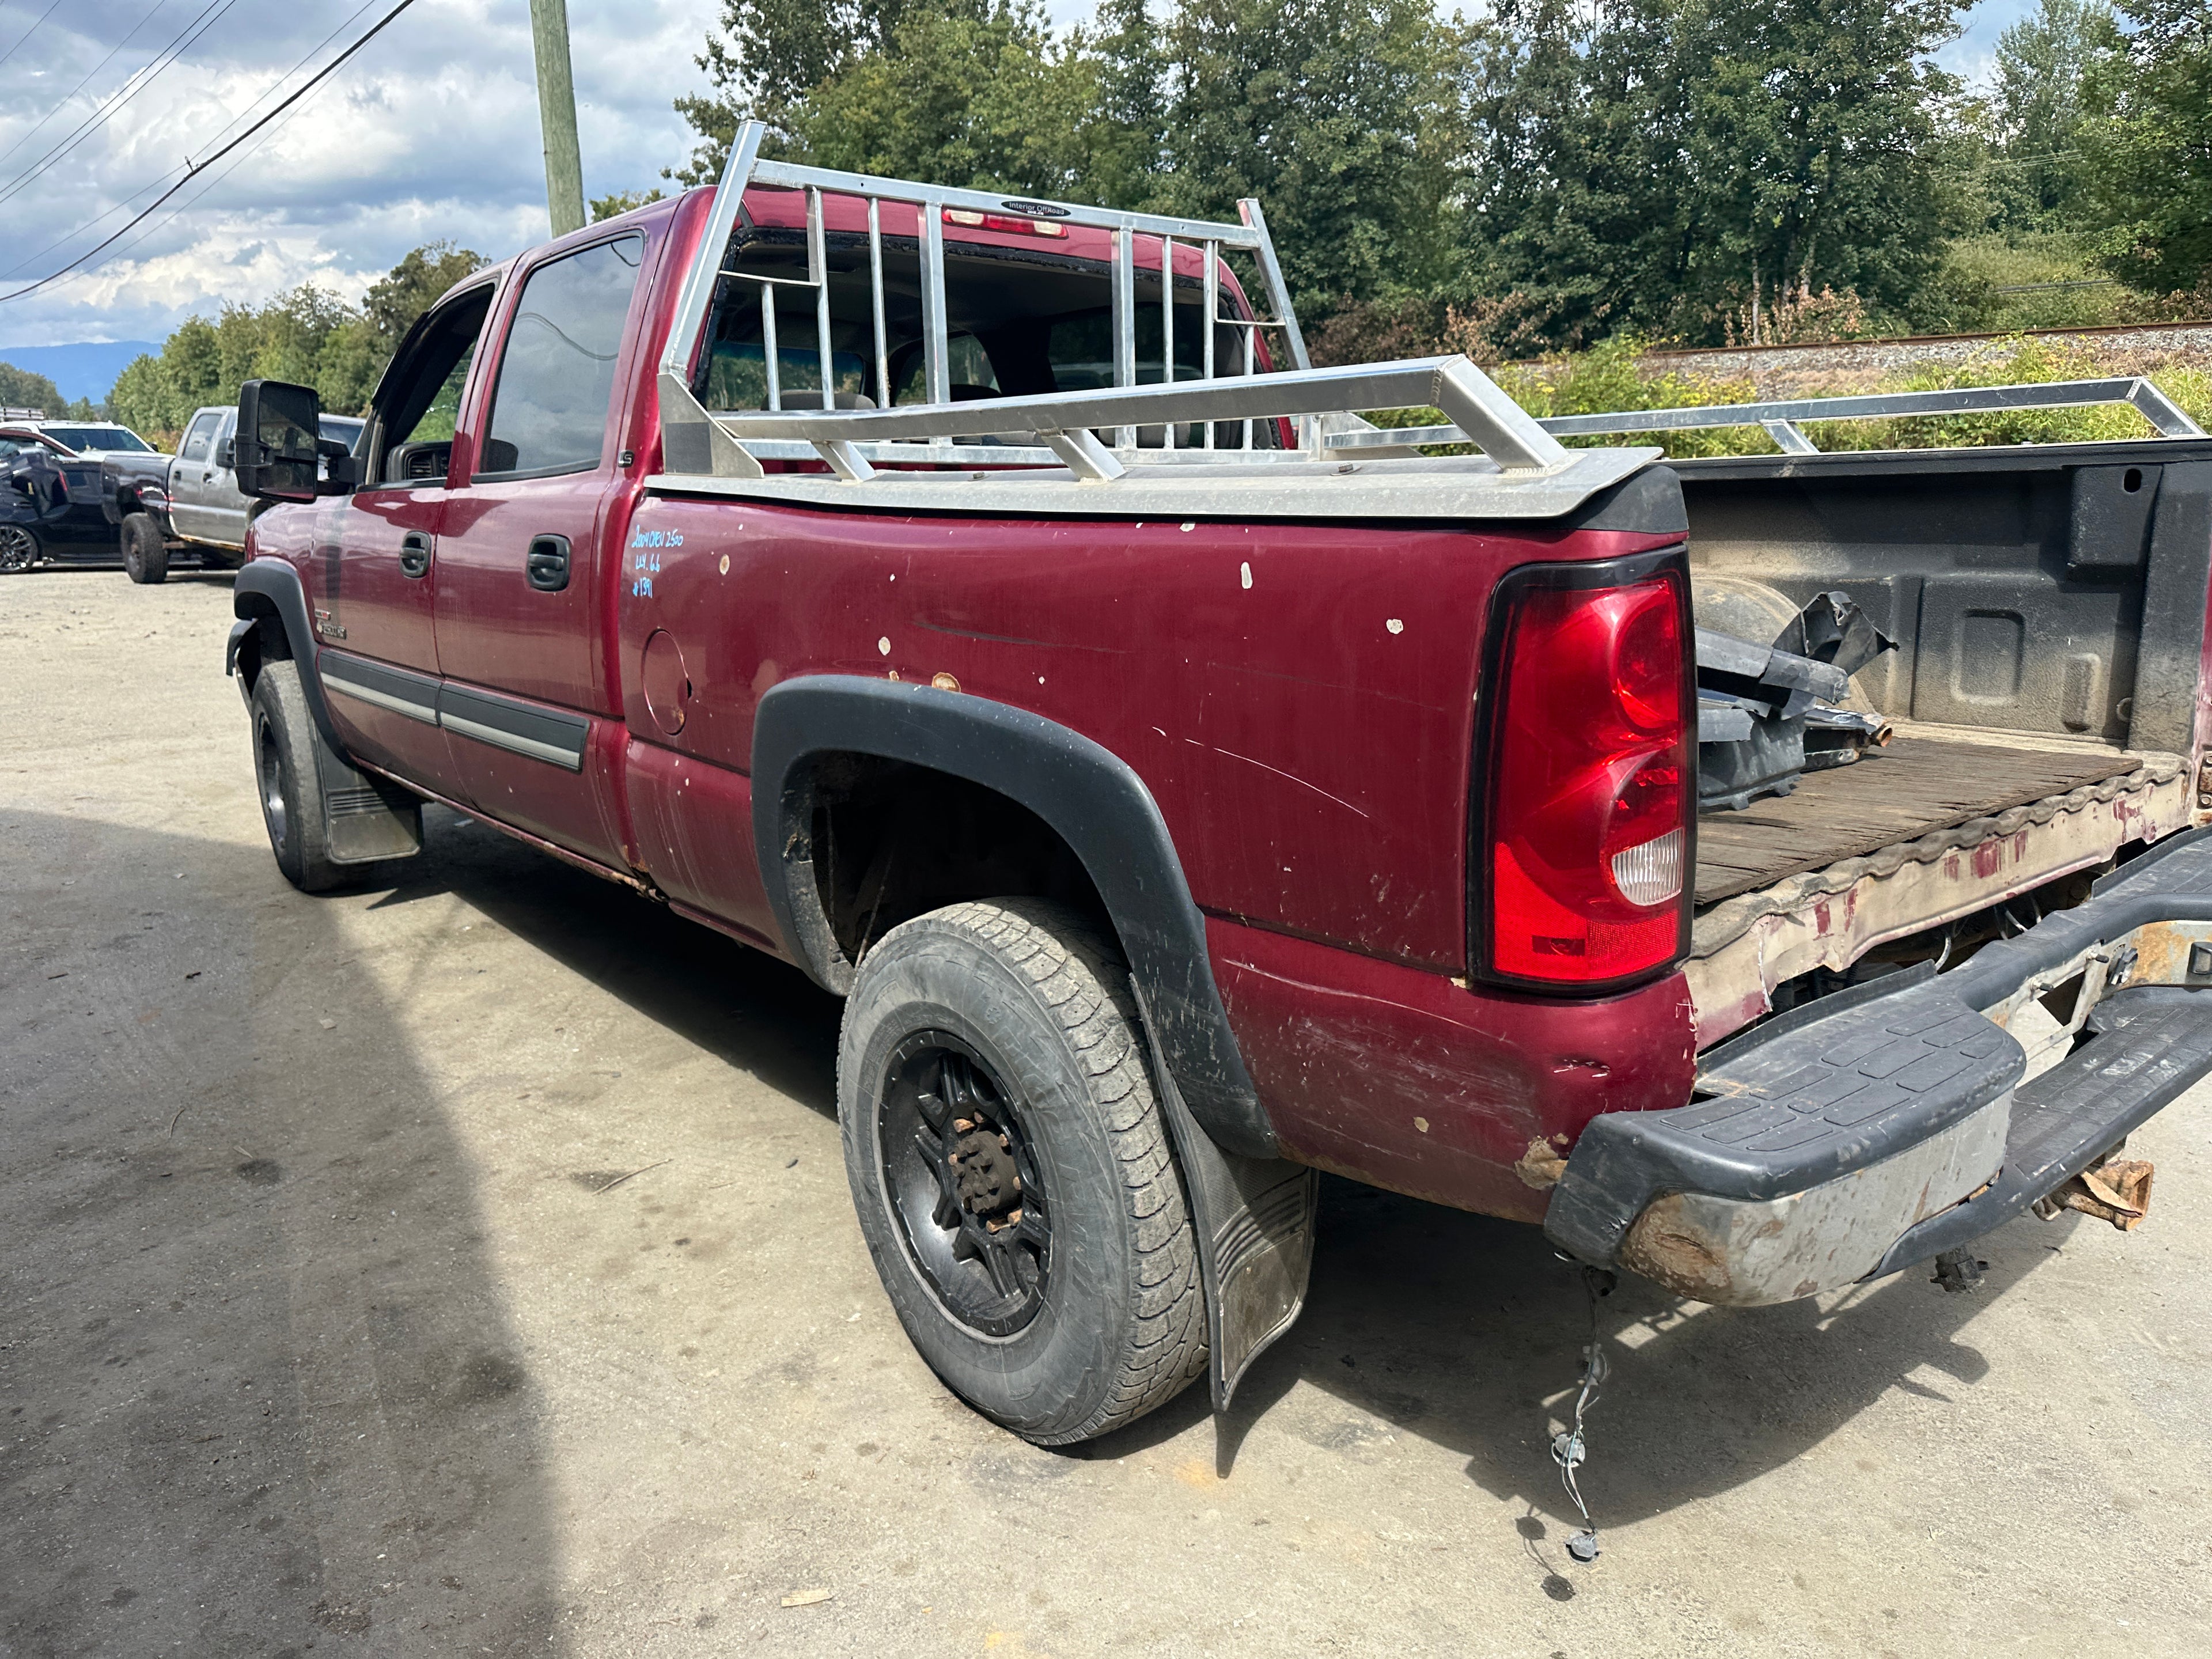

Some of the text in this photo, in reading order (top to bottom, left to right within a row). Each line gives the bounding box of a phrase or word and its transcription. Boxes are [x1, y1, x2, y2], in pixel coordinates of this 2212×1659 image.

[1009, 202, 1065, 215] Interior OffRoad
[618, 453, 632, 464] LS
[665, 529, 684, 547] 2500
